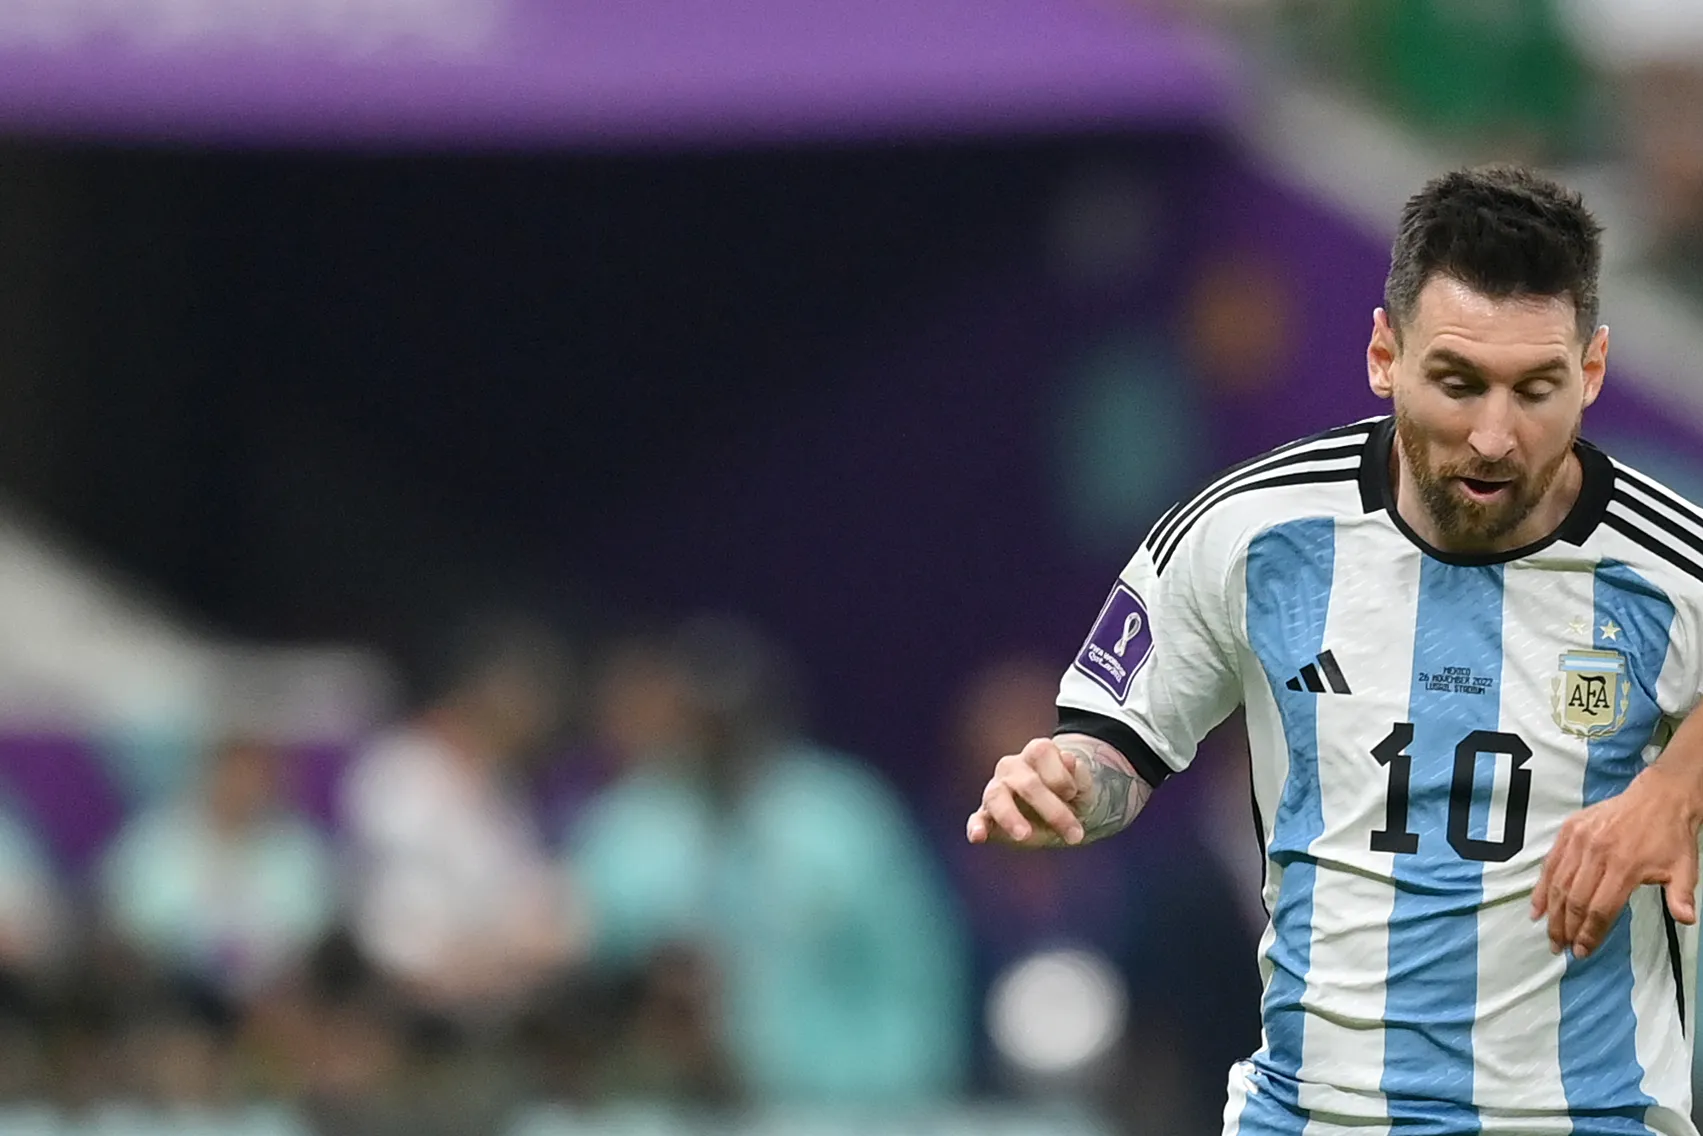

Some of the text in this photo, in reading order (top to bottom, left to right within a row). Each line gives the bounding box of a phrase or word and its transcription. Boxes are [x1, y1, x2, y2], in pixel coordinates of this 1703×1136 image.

[1418, 672, 1429, 682] 26
[1568, 673, 1610, 716] AFA
[1369, 722, 1533, 863] 10
